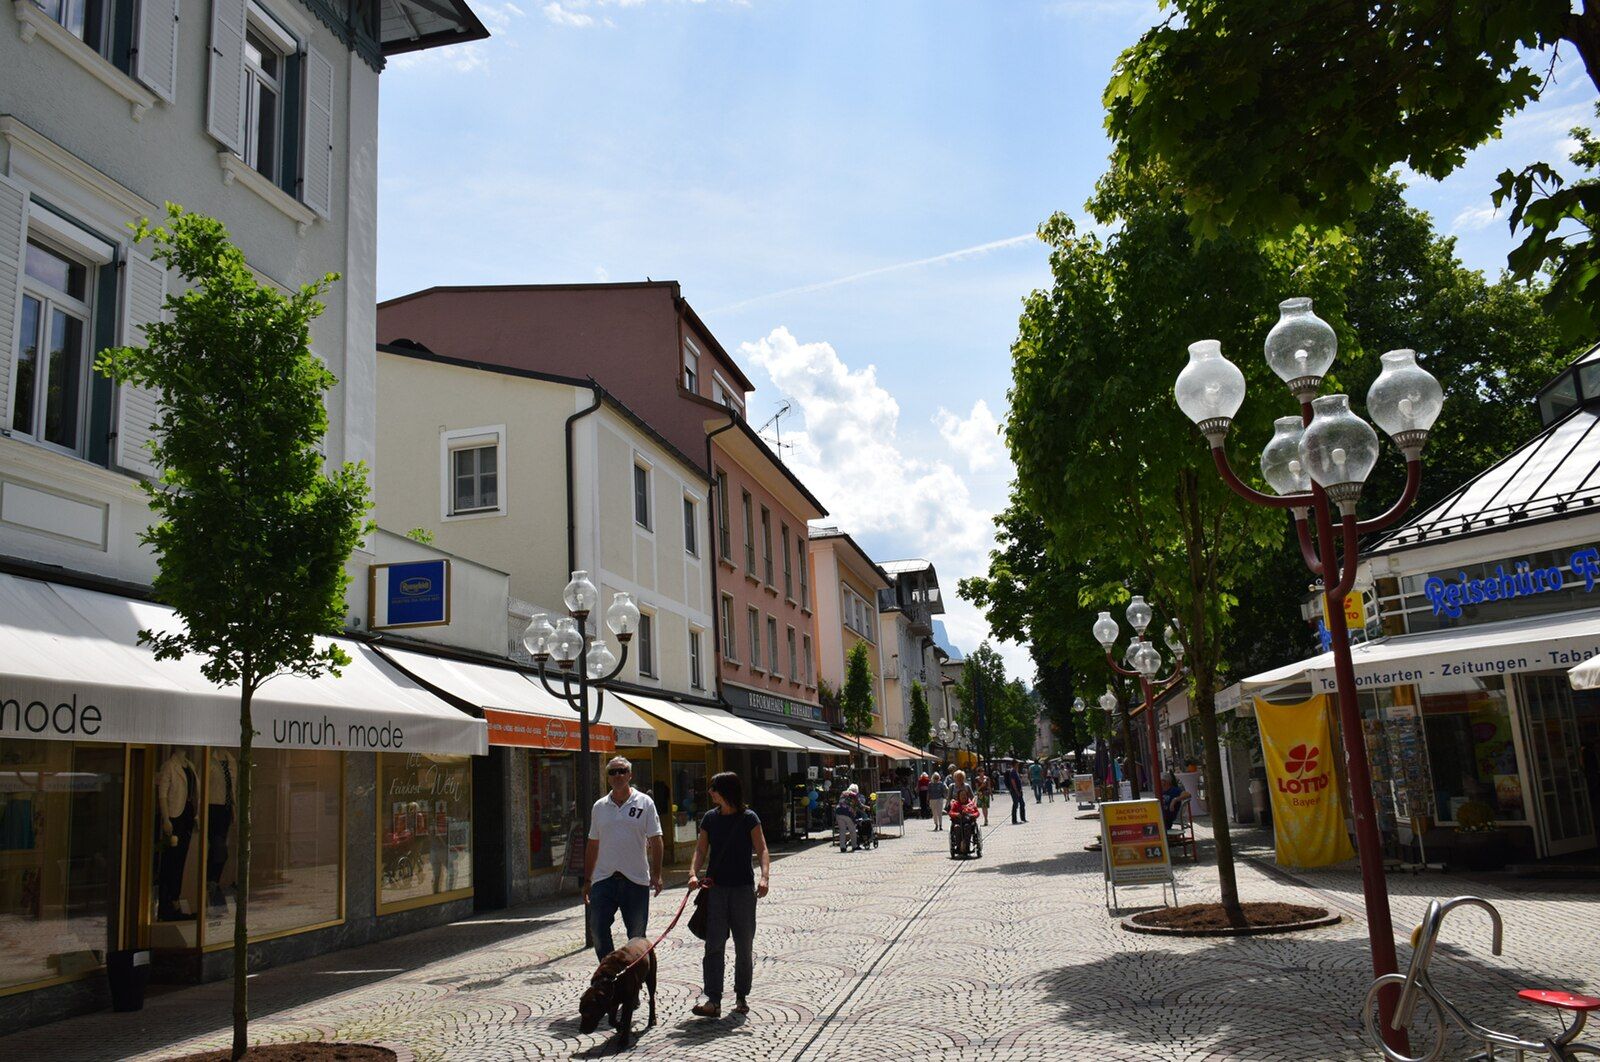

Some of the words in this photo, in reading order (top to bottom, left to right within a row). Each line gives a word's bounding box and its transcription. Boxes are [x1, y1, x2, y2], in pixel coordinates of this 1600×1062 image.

[1424, 561, 1563, 618] Reisebüro
[1320, 670, 1422, 689] Teonkarten
[1441, 658, 1527, 676] Zeitungen
[0, 693, 101, 735] mode
[273, 715, 341, 746] unruh.
[348, 720, 403, 748] mode
[1278, 773, 1328, 794] LOTTO
[628, 806, 643, 819] 87
[1147, 826, 1153, 834] 7
